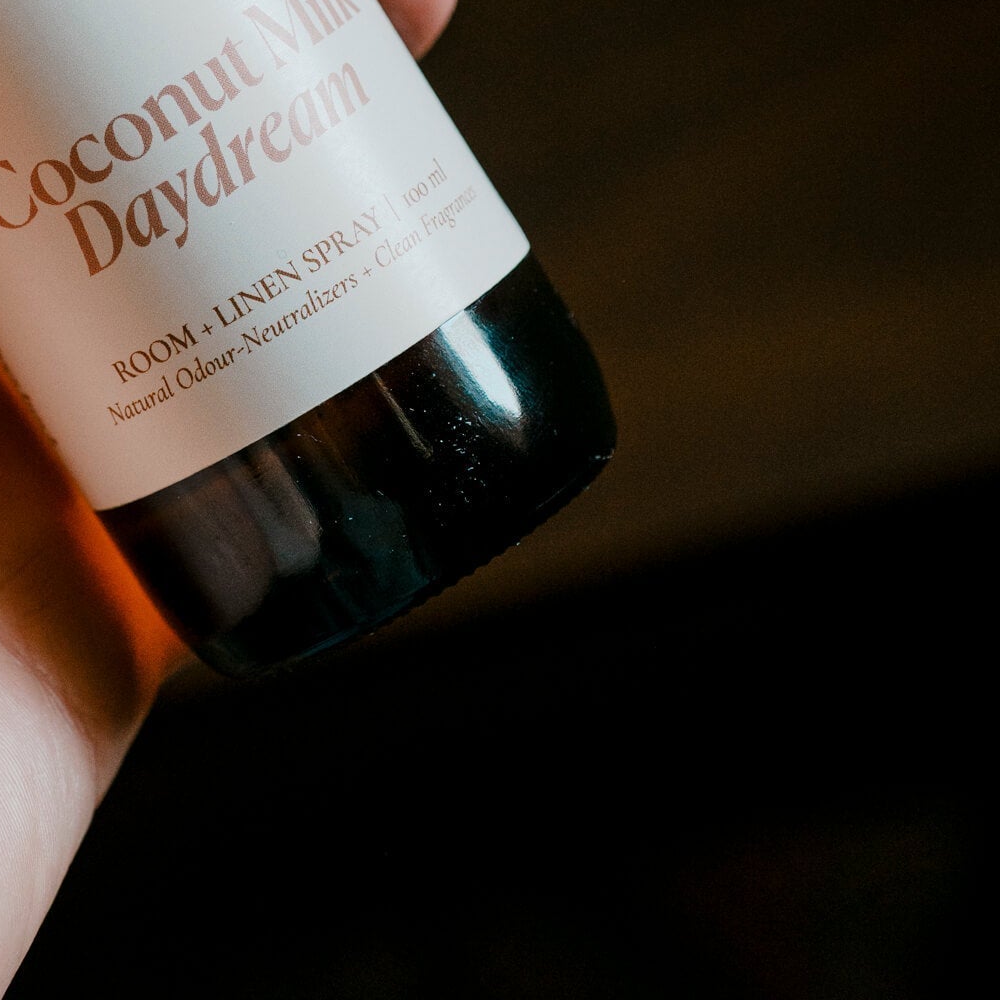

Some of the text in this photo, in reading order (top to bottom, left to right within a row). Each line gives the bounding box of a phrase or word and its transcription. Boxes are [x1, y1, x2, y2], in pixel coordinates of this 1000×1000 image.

[63, 62, 371, 278] Daydream
[111, 323, 199, 384] ROOM
[212, 260, 303, 328] LINEN
[302, 205, 382, 273] SPRAY
[402, 182, 429, 208] 100
[428, 157, 448, 188] ml
[107, 376, 175, 426] Natural
[175, 272, 359, 390] Odour-Neutralizers
[374, 230, 423, 268] Clean
